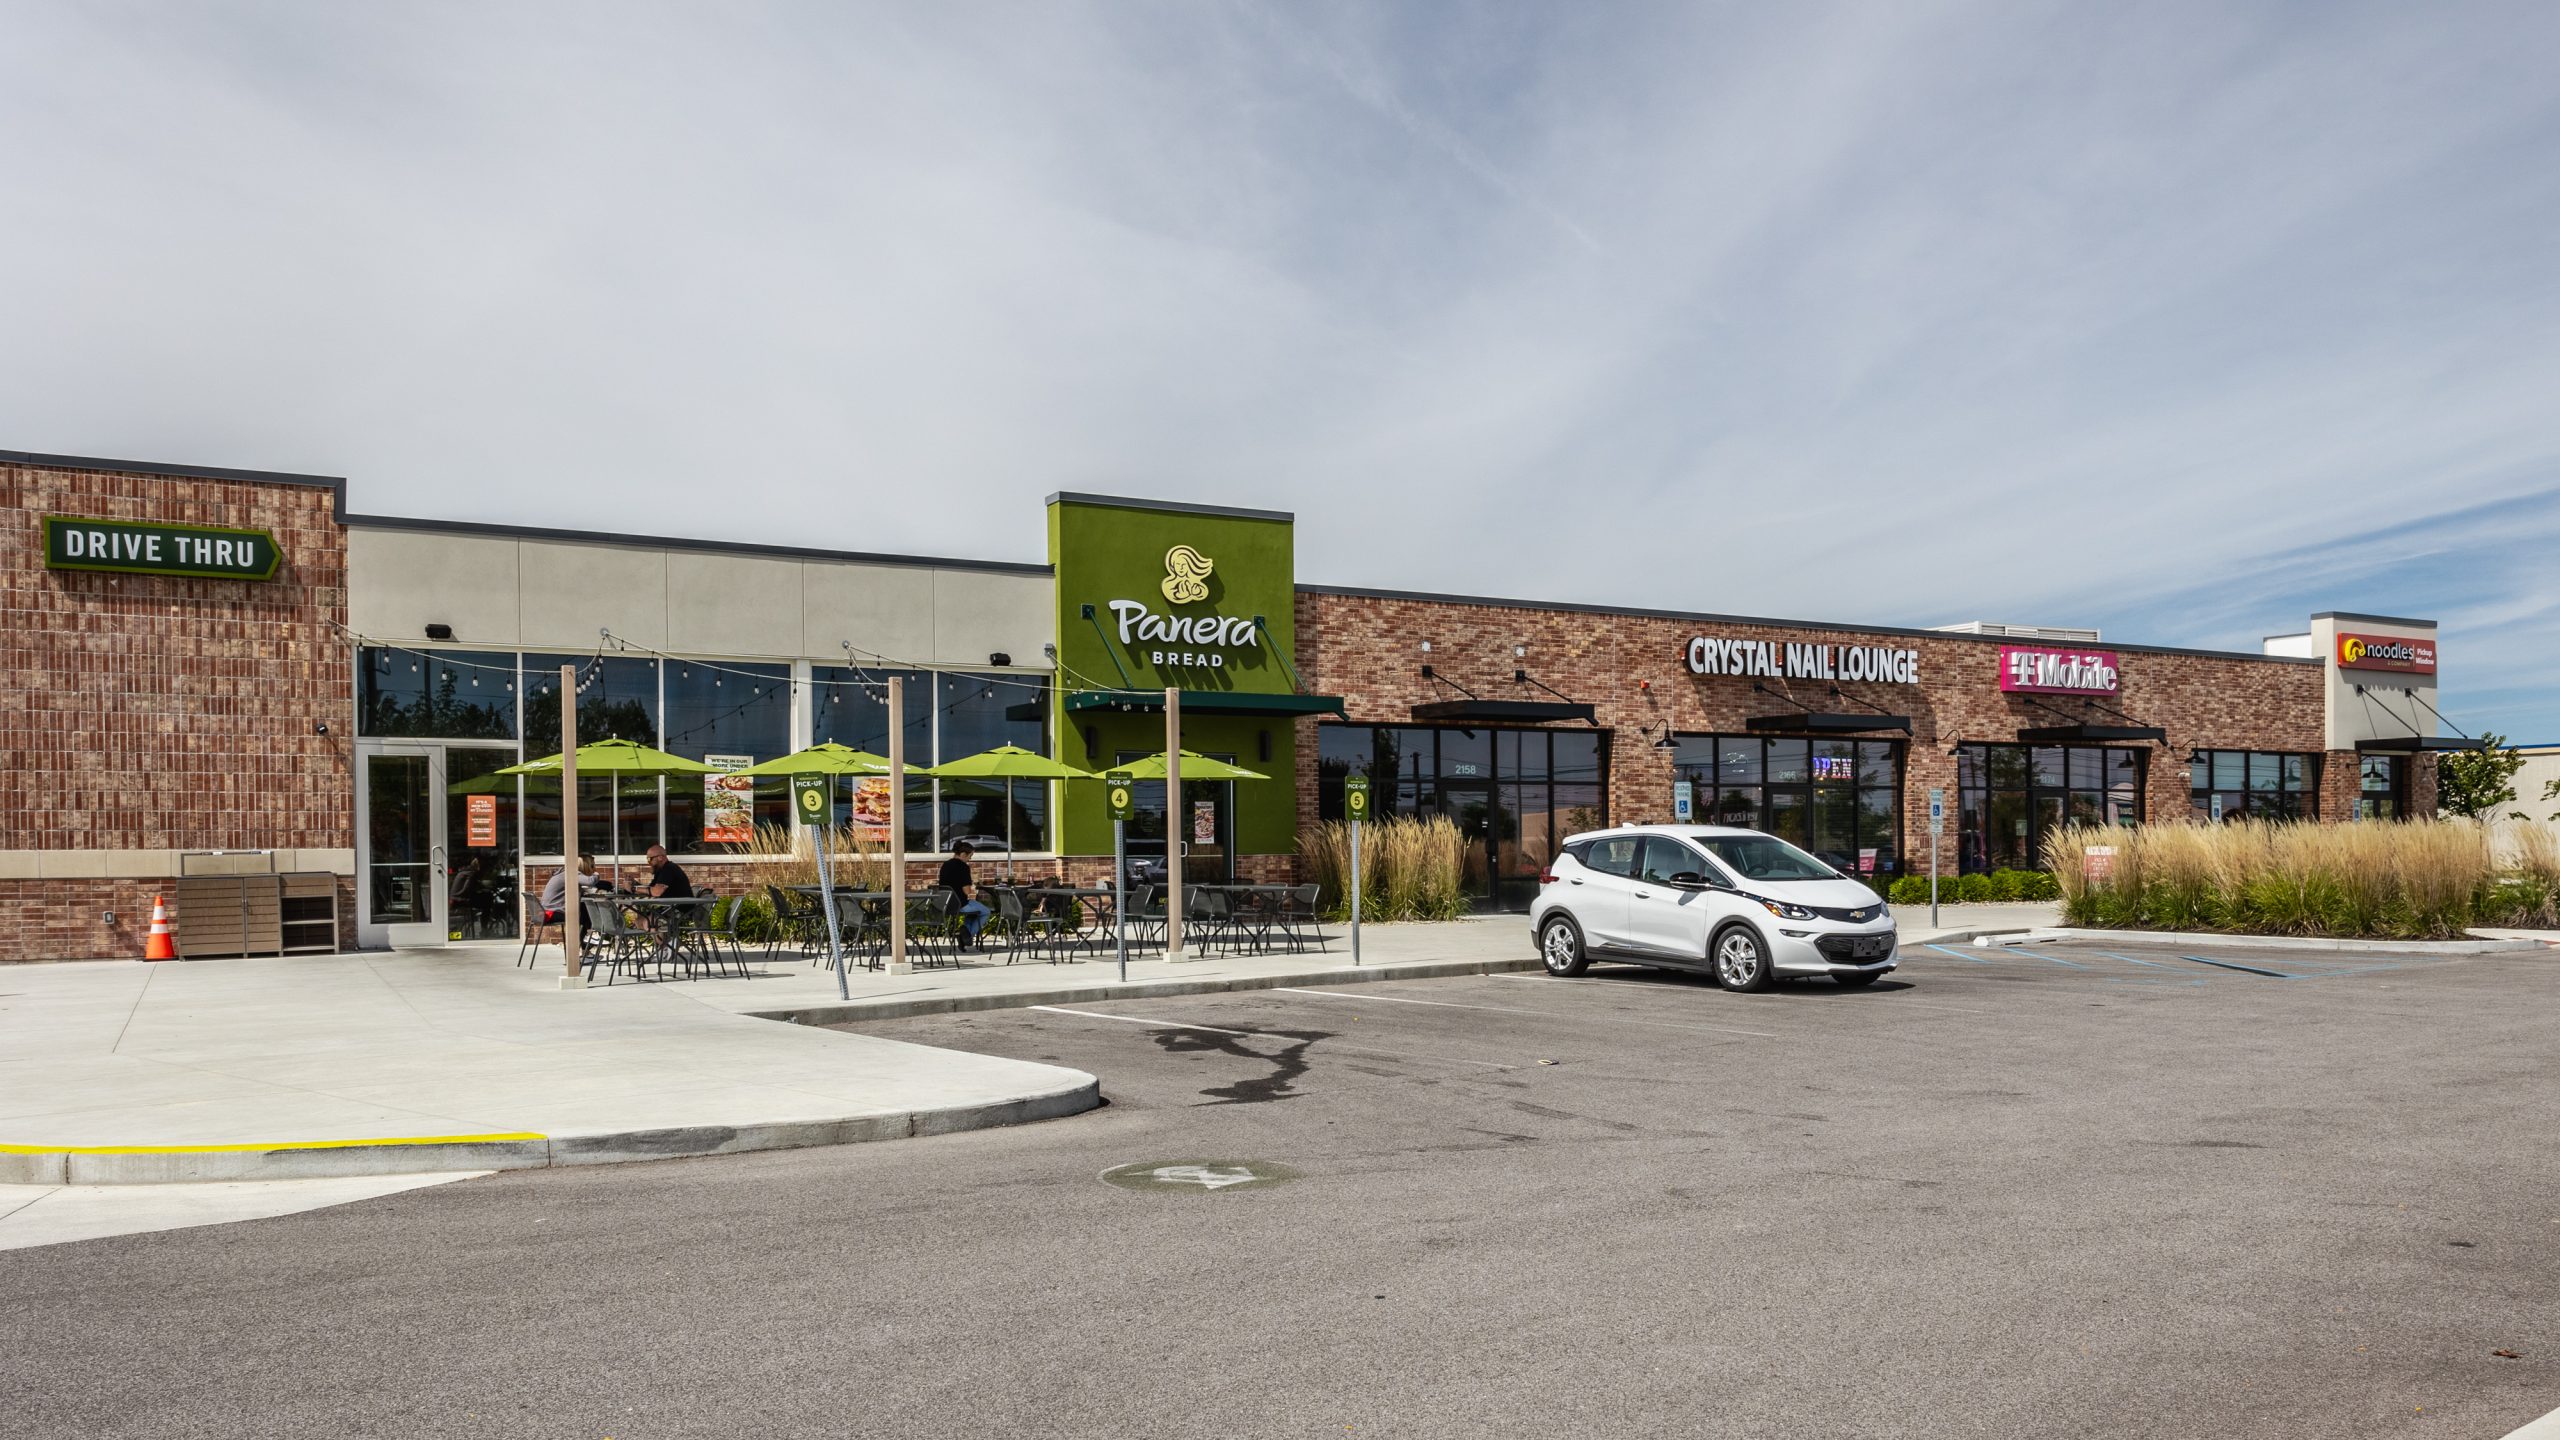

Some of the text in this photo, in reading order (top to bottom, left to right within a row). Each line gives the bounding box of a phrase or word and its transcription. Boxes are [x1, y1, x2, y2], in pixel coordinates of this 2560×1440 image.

[66, 529, 254, 567] DRIVE THRU
[1108, 599, 1257, 647] Panera
[2367, 642, 2413, 660] noodles
[2417, 648, 2433, 658] Pickup
[1152, 651, 1223, 668] BREAD
[1689, 636, 1919, 684] CRYSTAL NAIL LOUNGE
[2415, 657, 2435, 665] Window
[1455, 764, 1476, 775] 2158
[796, 780, 823, 788] PICK-UP
[808, 795, 817, 807] 3
[1115, 792, 1124, 804] 4
[1354, 796, 1361, 805] 5
